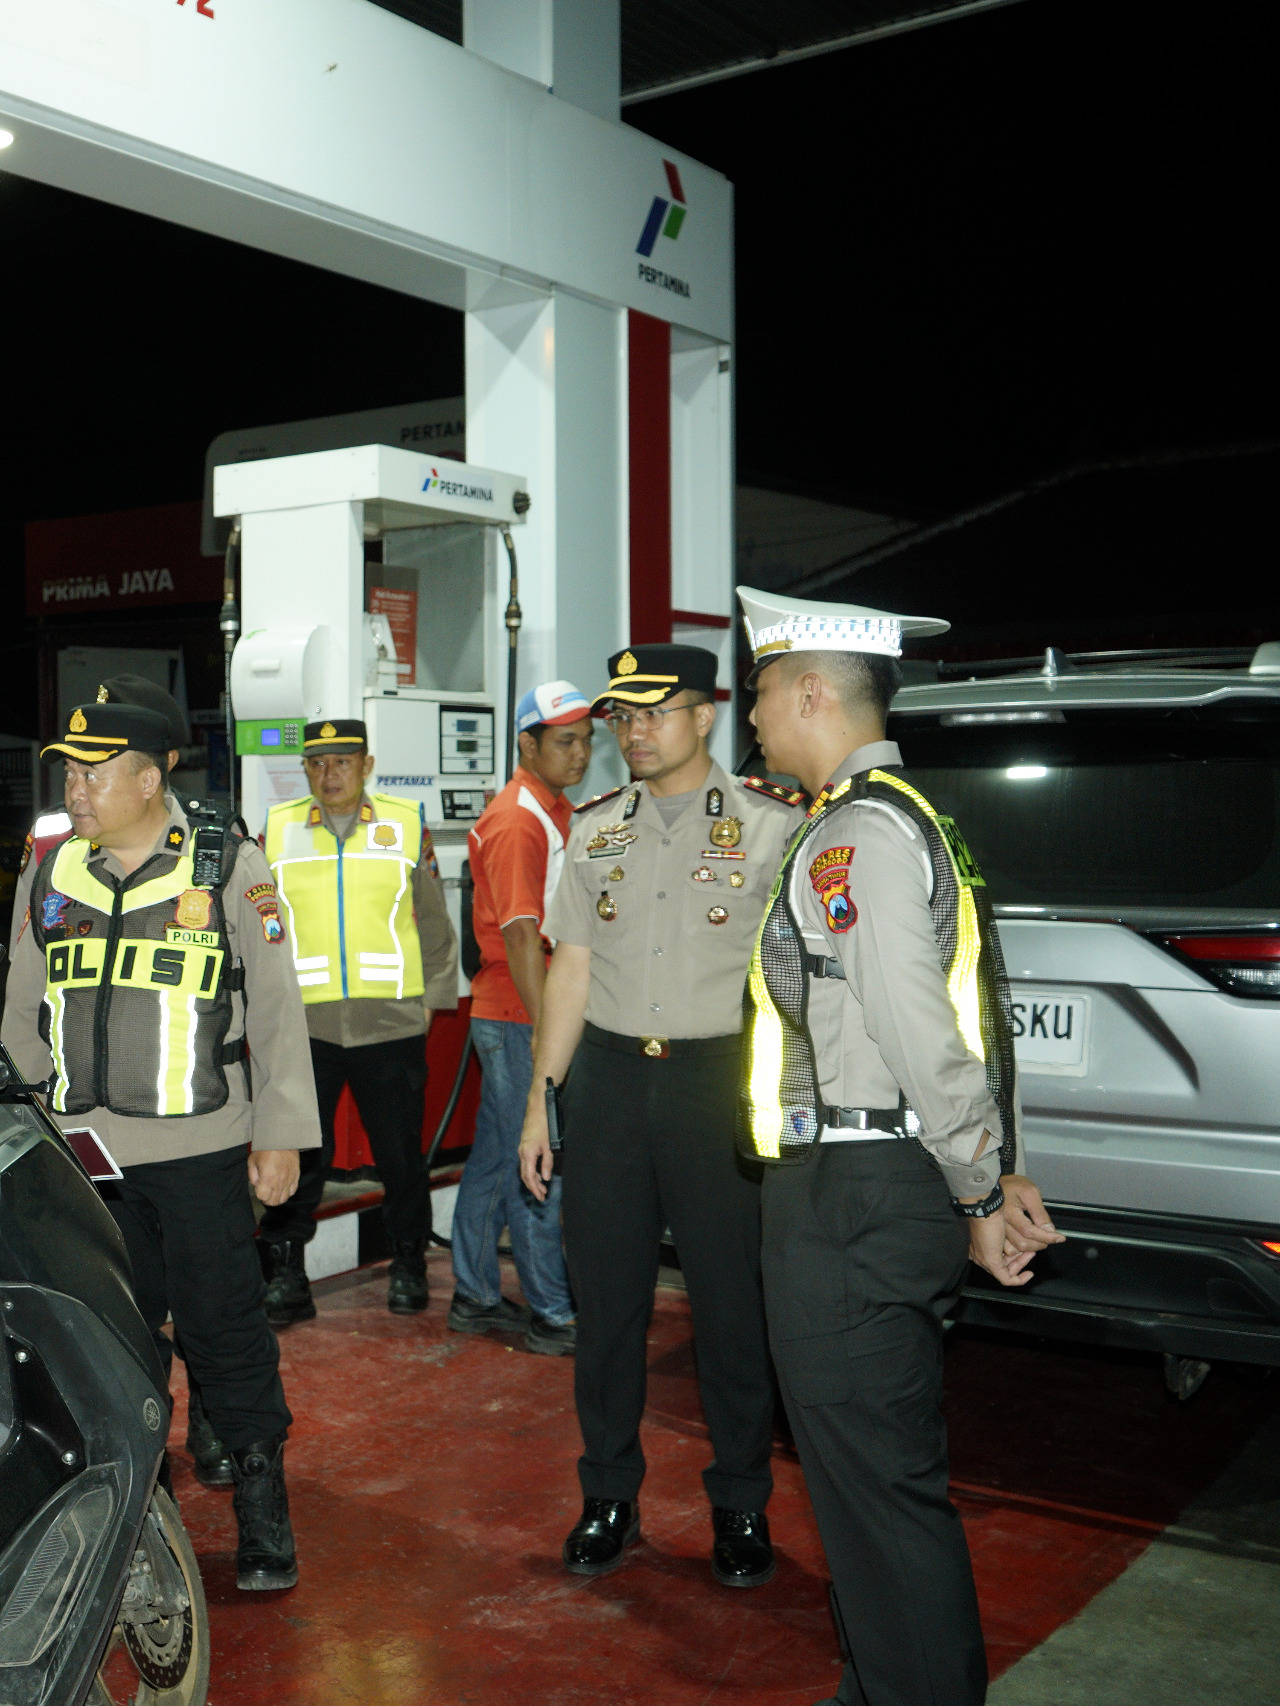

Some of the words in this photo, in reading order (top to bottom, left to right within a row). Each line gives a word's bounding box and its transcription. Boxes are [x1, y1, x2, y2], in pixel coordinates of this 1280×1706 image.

[638, 263, 691, 299] PERTAMINA
[440, 480, 493, 502] PERTAMINA
[119, 567, 174, 596] JAYA
[376, 776, 435, 787] PERTAMAX
[173, 932, 214, 944] POLRI
[1011, 1003, 1073, 1040] SKU
